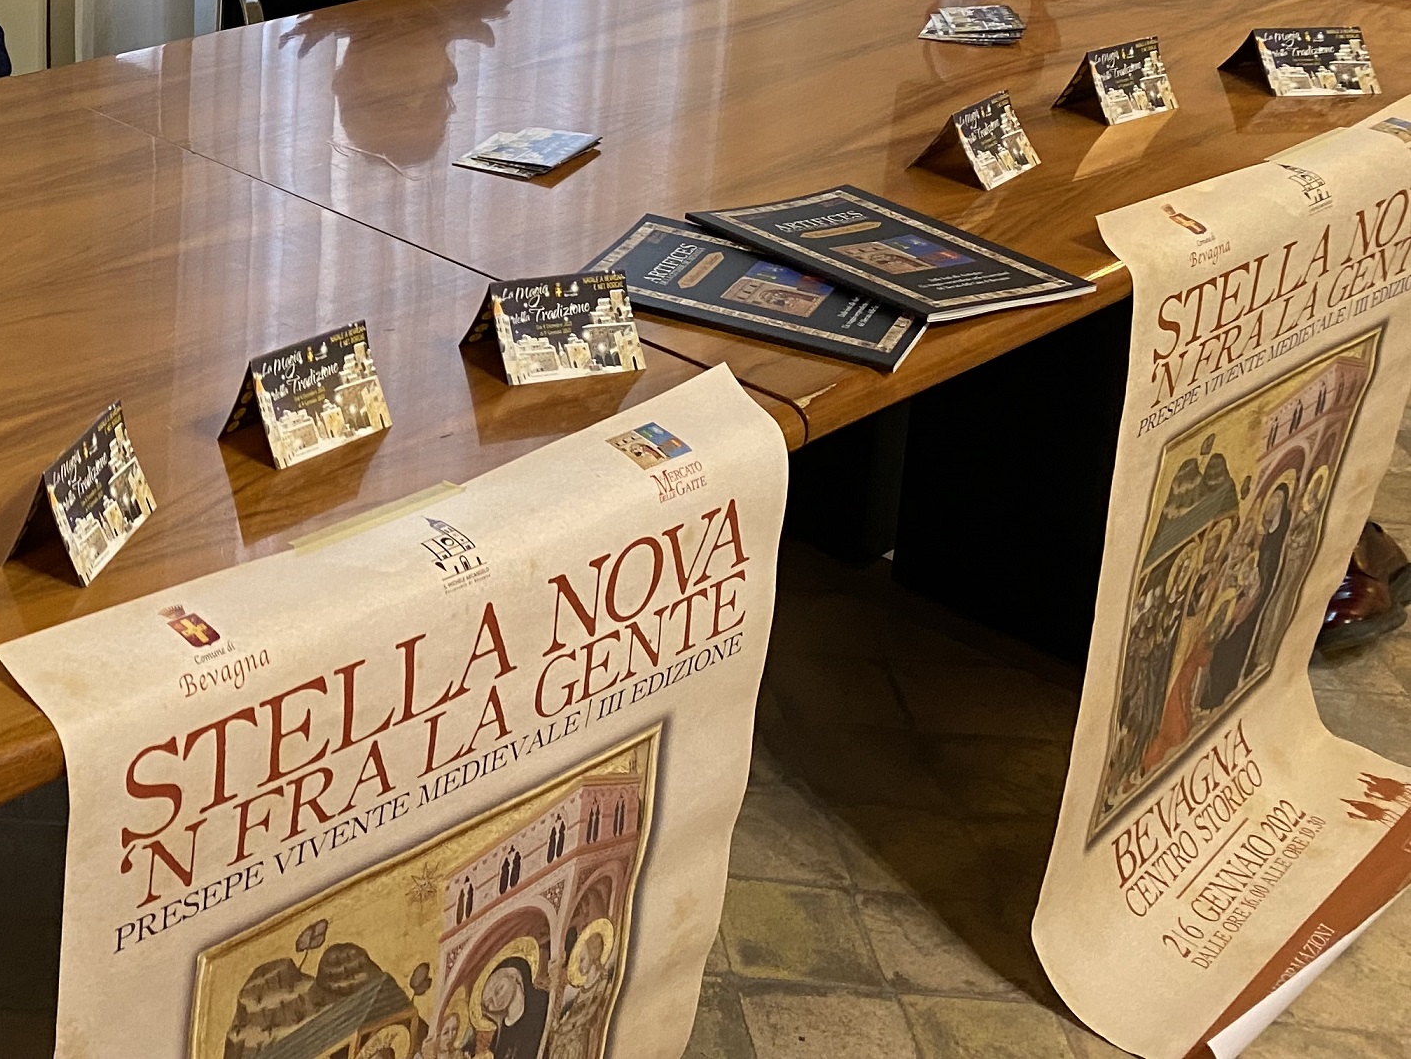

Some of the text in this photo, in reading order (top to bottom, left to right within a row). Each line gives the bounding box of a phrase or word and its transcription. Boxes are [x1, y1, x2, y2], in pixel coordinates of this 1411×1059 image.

[774, 210, 865, 233] ARTIFICES
[643, 243, 698, 284] ARTIFICES
[1153, 188, 1411, 365] STELLA NO
[1190, 241, 1231, 267] Bevagna
[502, 283, 550, 308] La Magia
[510, 302, 590, 325] della Tradizione
[1187, 309, 1262, 387] FRA
[1271, 281, 1318, 340] LA
[262, 350, 303, 380] La Magia
[288, 362, 338, 394] Tradizione
[1137, 385, 1201, 438] PRESEPE
[1204, 349, 1266, 396] VIVENTE
[1267, 307, 1346, 363] MEDIEVALE
[650, 460, 703, 496] MERCATO
[675, 475, 708, 496] GAITE
[121, 498, 750, 849] STELLA NOVA
[179, 649, 270, 698] Bevagna
[193, 640, 236, 665] Comune di
[227, 739, 396, 867] FRA
[417, 685, 513, 779] LA
[534, 569, 746, 718] GENTE
[113, 861, 265, 954] PRESEPE
[273, 792, 411, 875] VIVENTE
[416, 710, 581, 808] MEDIEVALE
[596, 689, 626, 721] III
[629, 632, 744, 705] EDIZIONE
[1110, 718, 1253, 889] BEVAGNA
[1124, 760, 1263, 917] CENTRO STORICO
[1191, 834, 1276, 922] GENNAIO
[1260, 799, 1307, 843] 2022
[1191, 931, 1233, 970] DALLE
[1222, 907, 1251, 933] ORE
[1240, 884, 1270, 910] 16.00
[1260, 857, 1292, 887] ALLE
[1282, 836, 1310, 860] ORE
